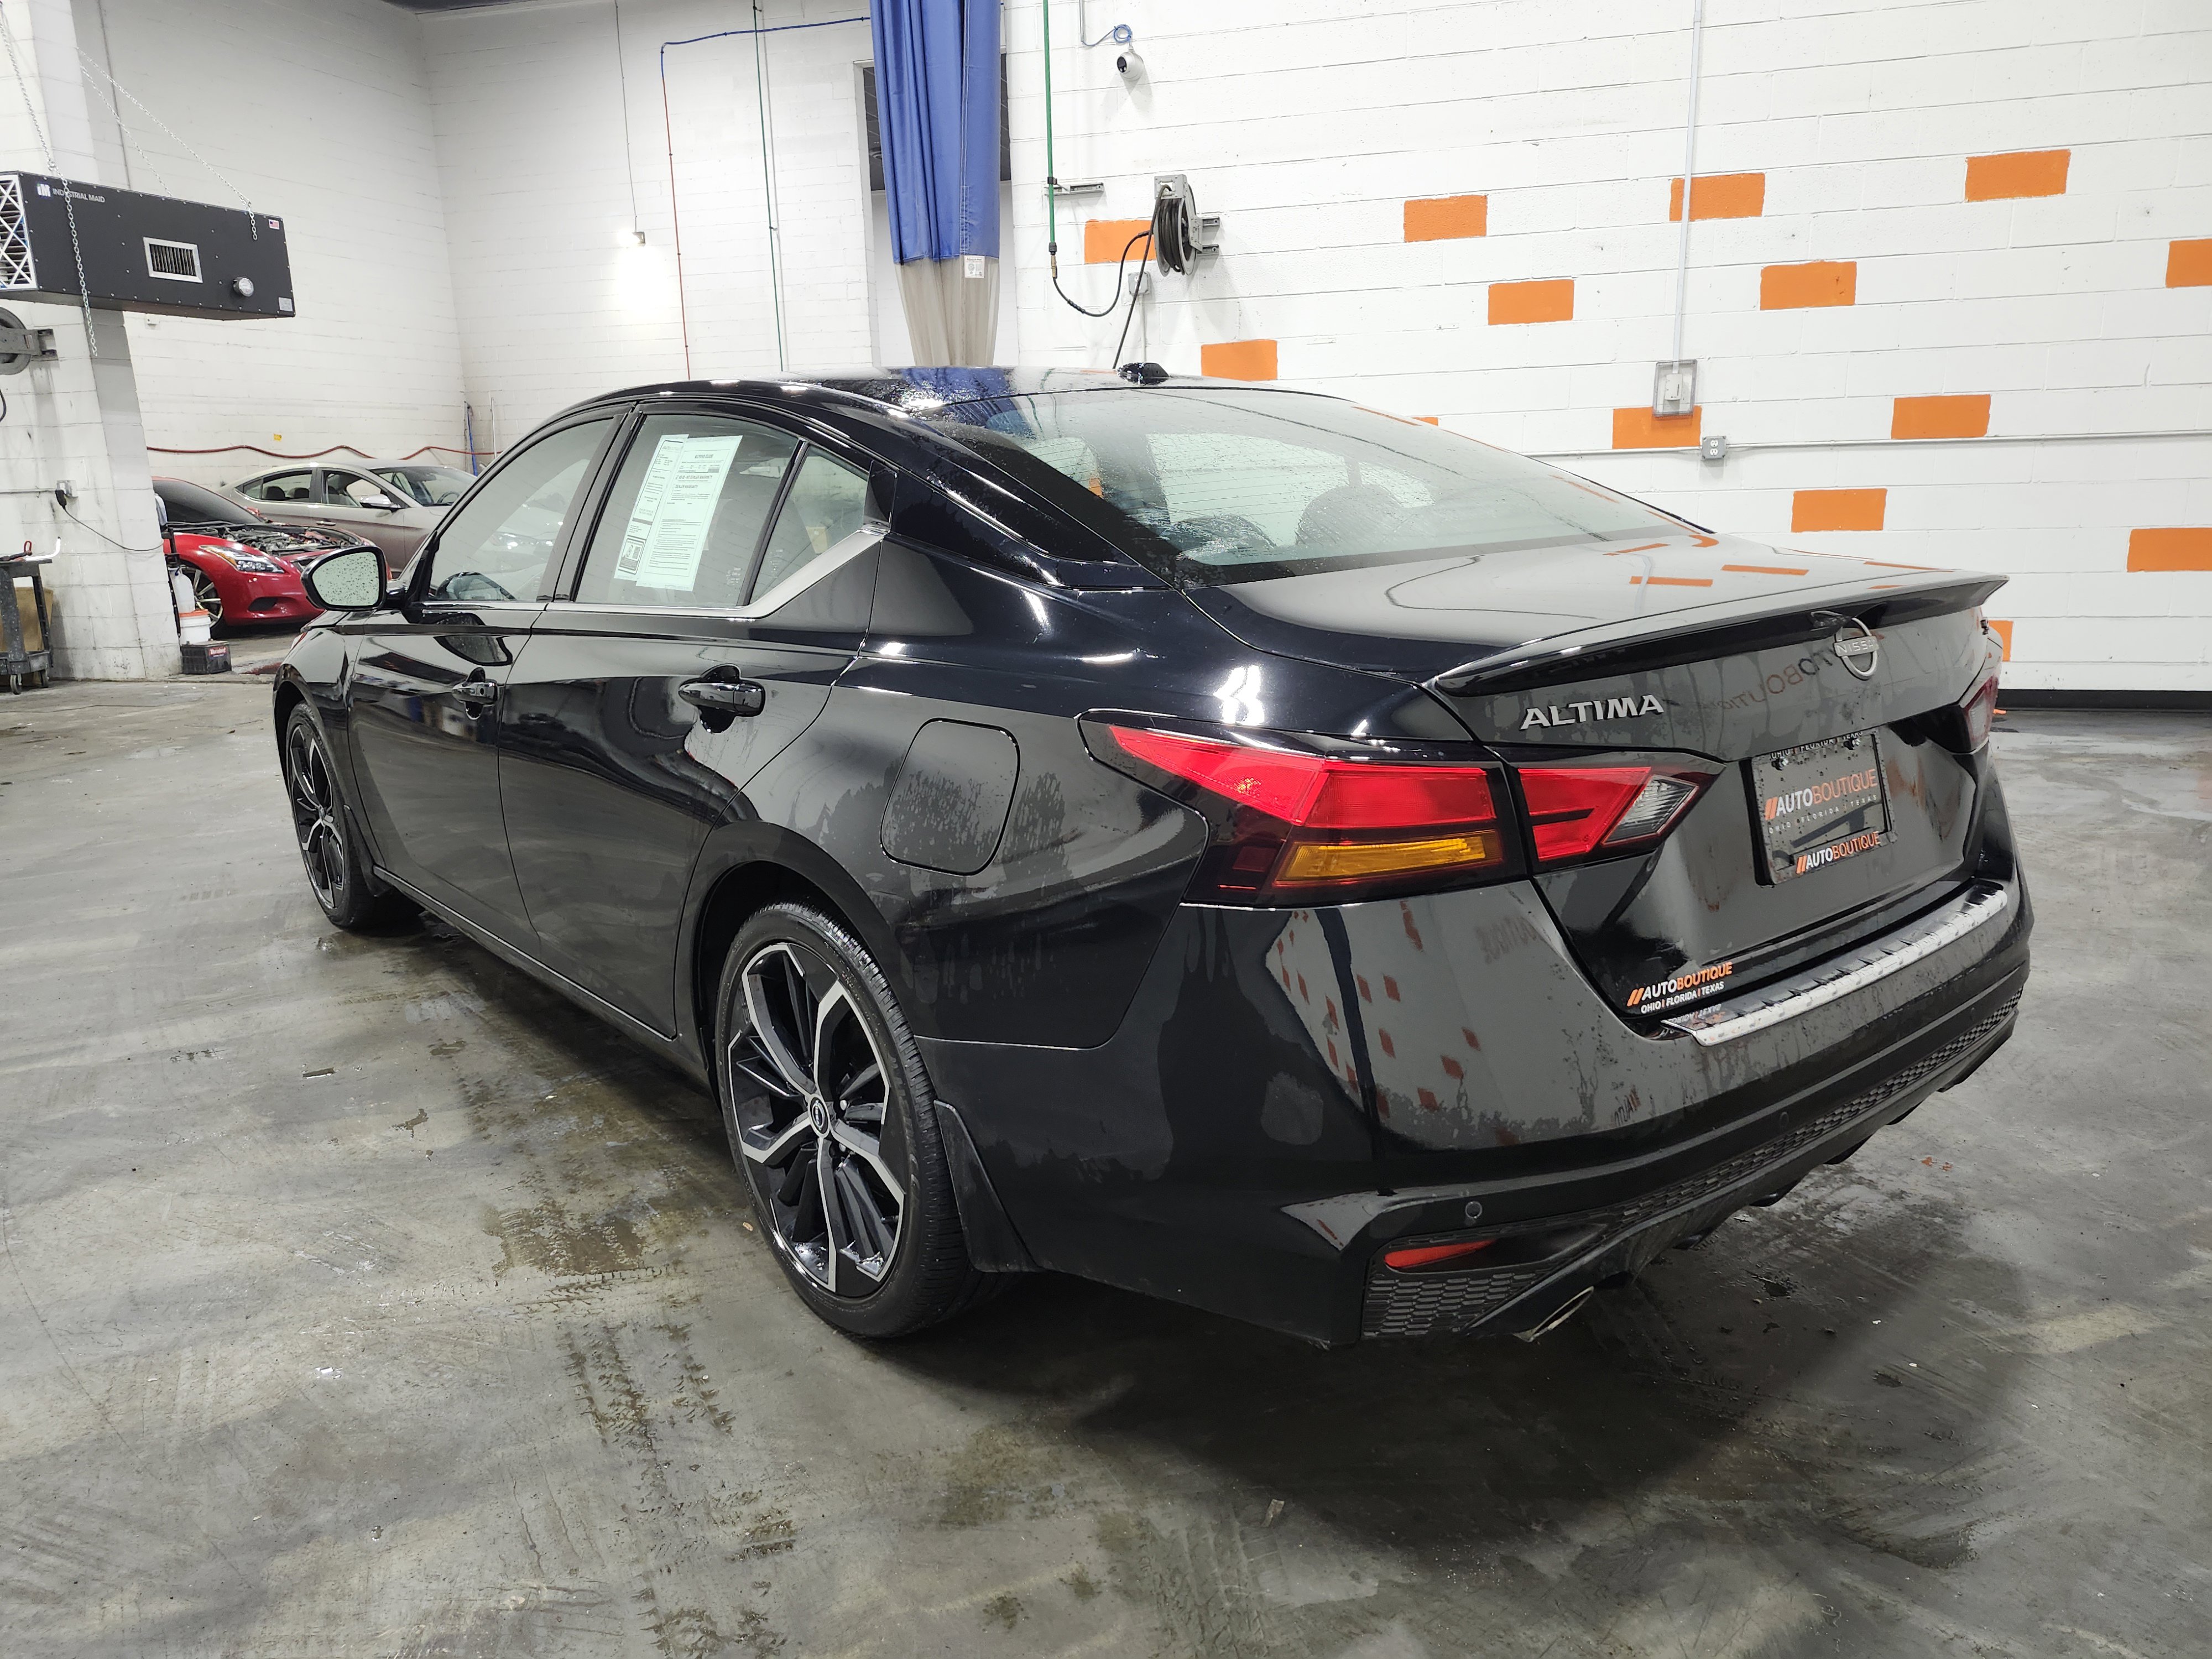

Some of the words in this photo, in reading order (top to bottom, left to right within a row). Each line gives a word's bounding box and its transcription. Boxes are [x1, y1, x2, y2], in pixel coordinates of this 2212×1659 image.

[53, 188, 88, 200] INDSTRIAL
[88, 194, 105, 202] MAID
[1520, 695, 1664, 729] ALTIMA
[1776, 769, 1878, 817] AUTOBOUTIQUE
[1769, 821, 1791, 834] OHIO
[1801, 806, 1839, 823] FLORIDA
[1850, 794, 1877, 807] TEXAS
[1806, 831, 1881, 870] AUTOBOUTIQUE
[1641, 961, 1733, 1001] AUTOBOUTIQUE
[1641, 1000, 1661, 1014] OHIO
[1666, 990, 1697, 1007] FLORIDA
[1701, 981, 1724, 995] TEXAS
